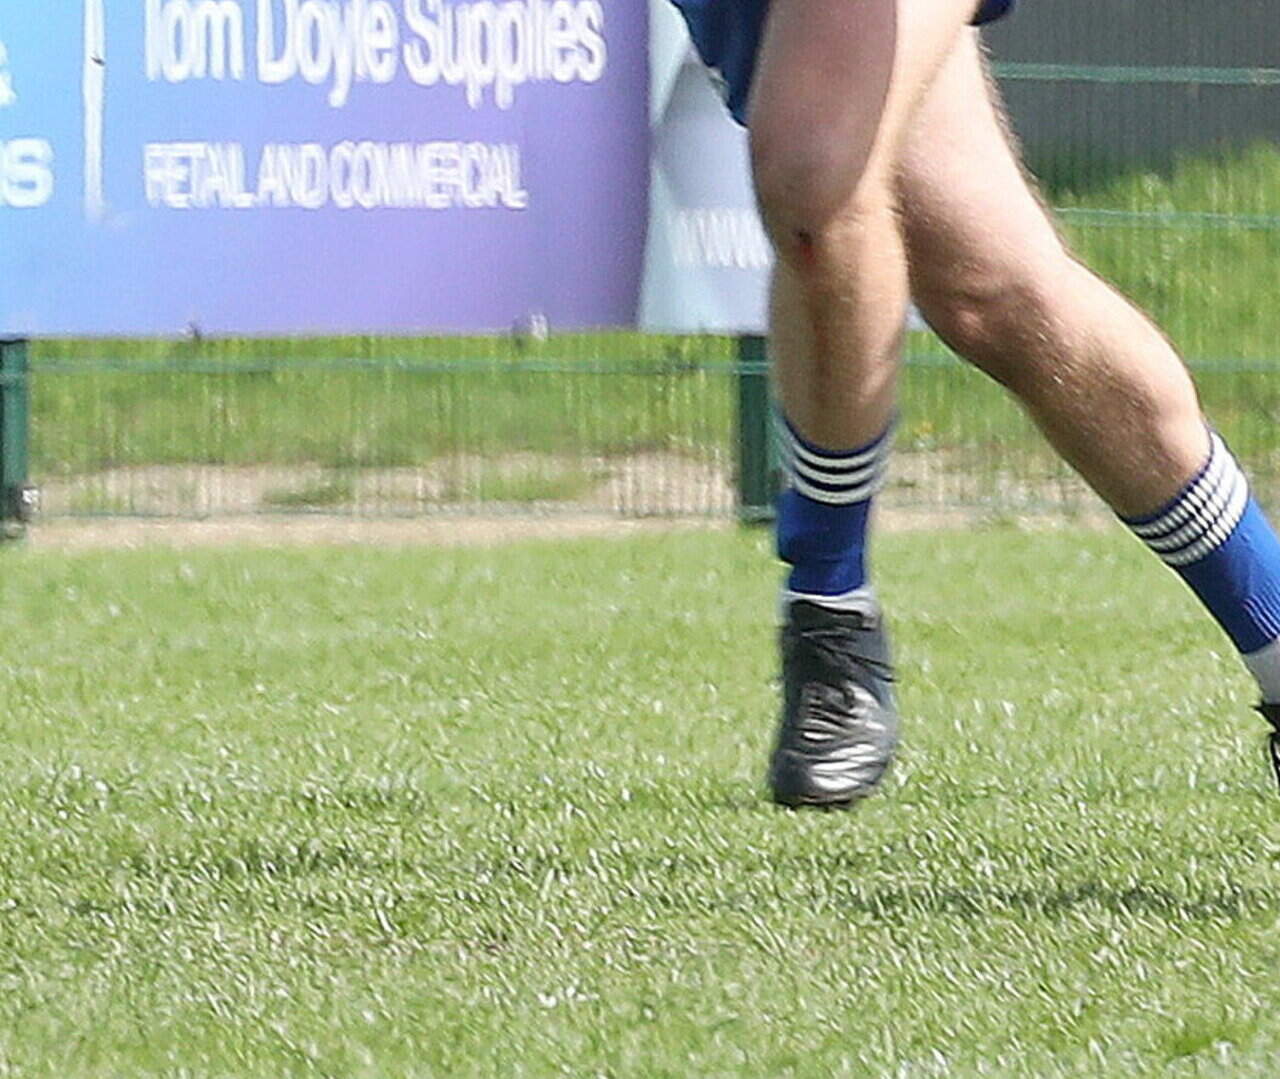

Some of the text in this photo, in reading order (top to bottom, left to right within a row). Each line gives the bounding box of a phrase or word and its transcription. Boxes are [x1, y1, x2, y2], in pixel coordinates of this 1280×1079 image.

[143, 140, 529, 210] RETAIL AND COMMERCIAL
